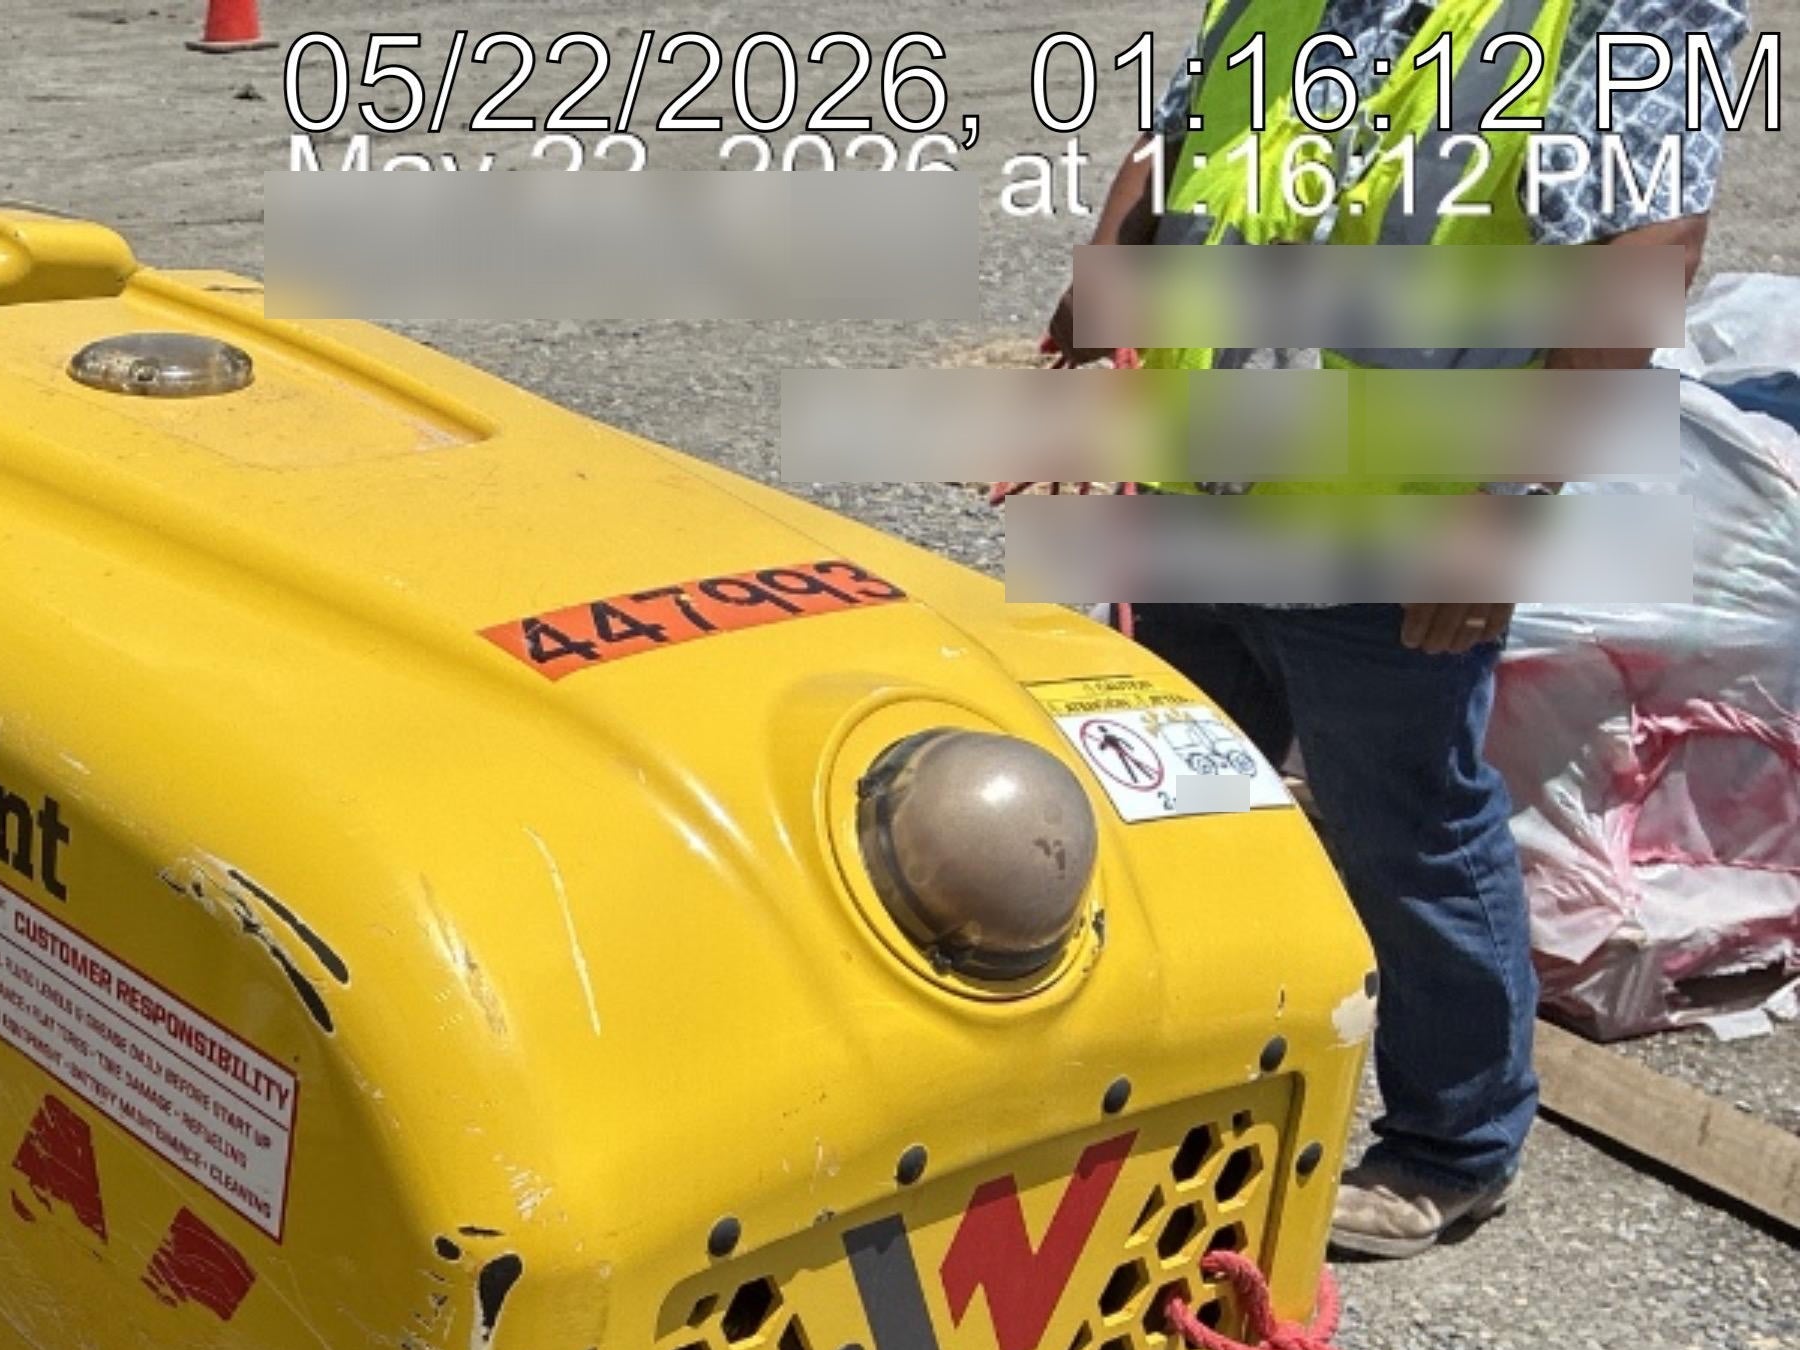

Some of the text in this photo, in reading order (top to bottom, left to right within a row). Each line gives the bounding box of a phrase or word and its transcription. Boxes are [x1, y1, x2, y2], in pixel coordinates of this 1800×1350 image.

[519, 559, 908, 665] 447993
[14, 907, 290, 1114] CUSTOMER RESPONSIBILITY
[164, 1063, 211, 1112] BEFORE
[211, 1096, 252, 1141] START
[253, 1125, 272, 1155] UP
[208, 1159, 272, 1221] CLEANING
